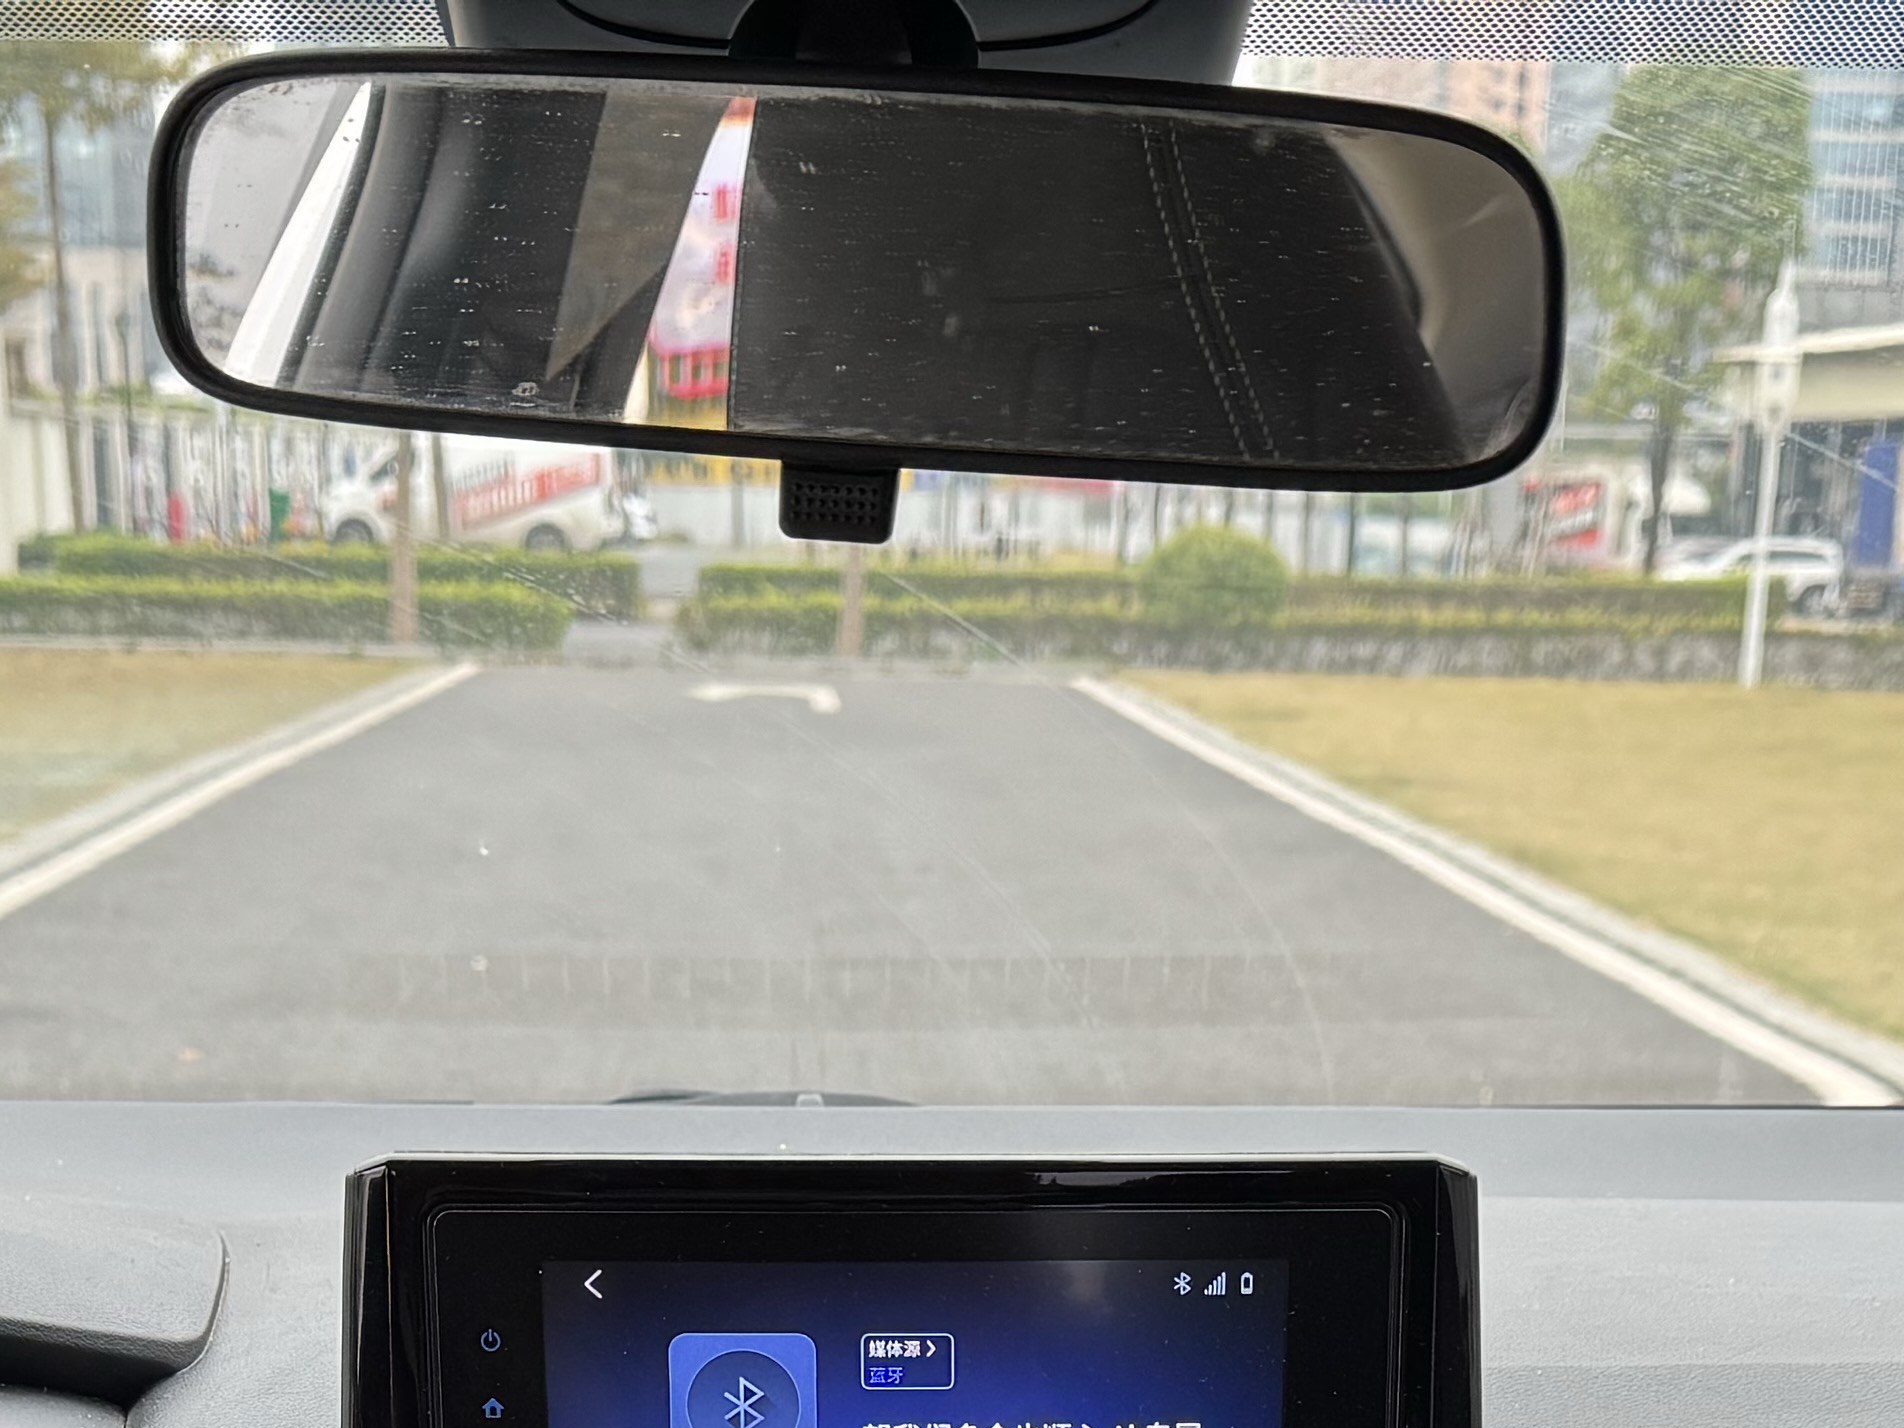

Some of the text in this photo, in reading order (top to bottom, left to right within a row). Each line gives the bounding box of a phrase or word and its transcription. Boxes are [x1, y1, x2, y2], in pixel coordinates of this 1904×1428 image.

[868, 1340, 922, 1358] 媒体源
[868, 1366, 904, 1384] 蓝牙
